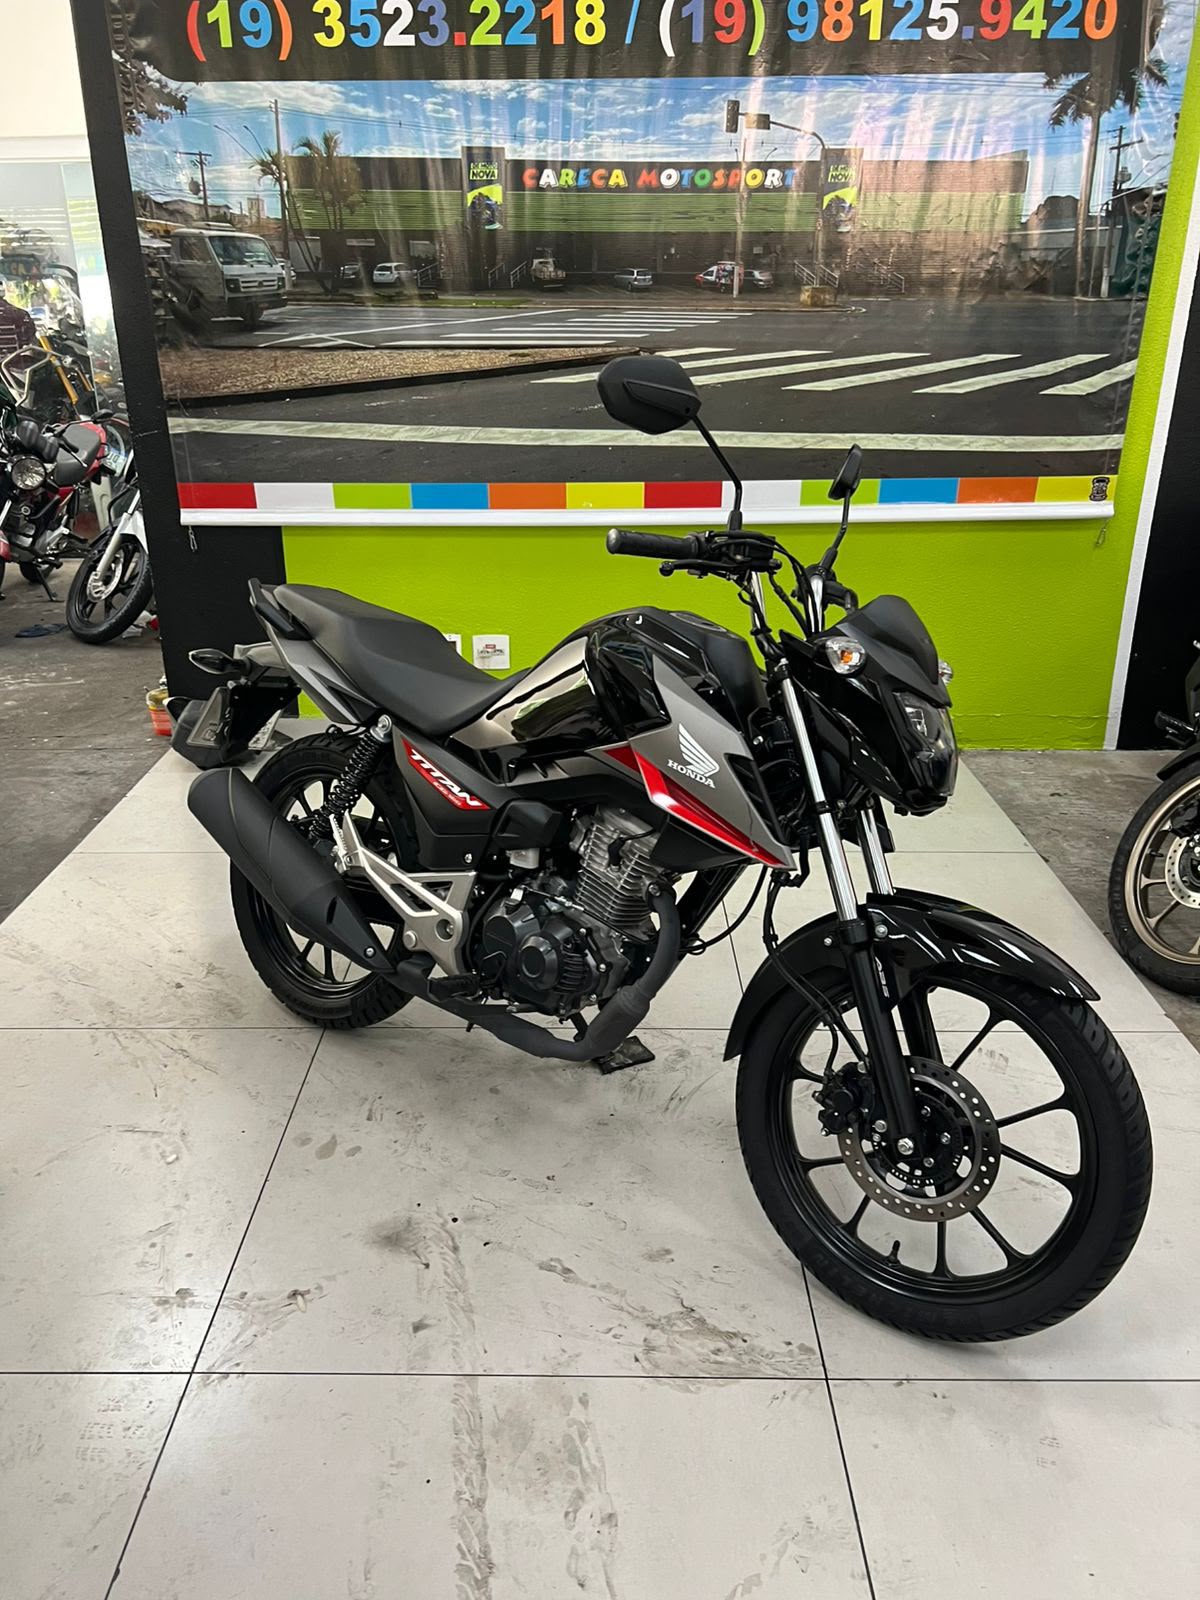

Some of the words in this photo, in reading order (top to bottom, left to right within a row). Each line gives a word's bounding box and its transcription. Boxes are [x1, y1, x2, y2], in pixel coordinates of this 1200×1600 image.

[187, 0, 293, 62] (19)
[313, 0, 606, 48] 3523.2218
[626, 0, 639, 45] /
[660, 0, 766, 57] (19)
[788, 0, 1118, 43] 98125.9420
[471, 169, 497, 179] NOVA
[522, 167, 629, 189] CARECA
[636, 167, 797, 189] MOTOSPORT
[410, 748, 483, 807] TITAN
[667, 759, 716, 789] HONDA
